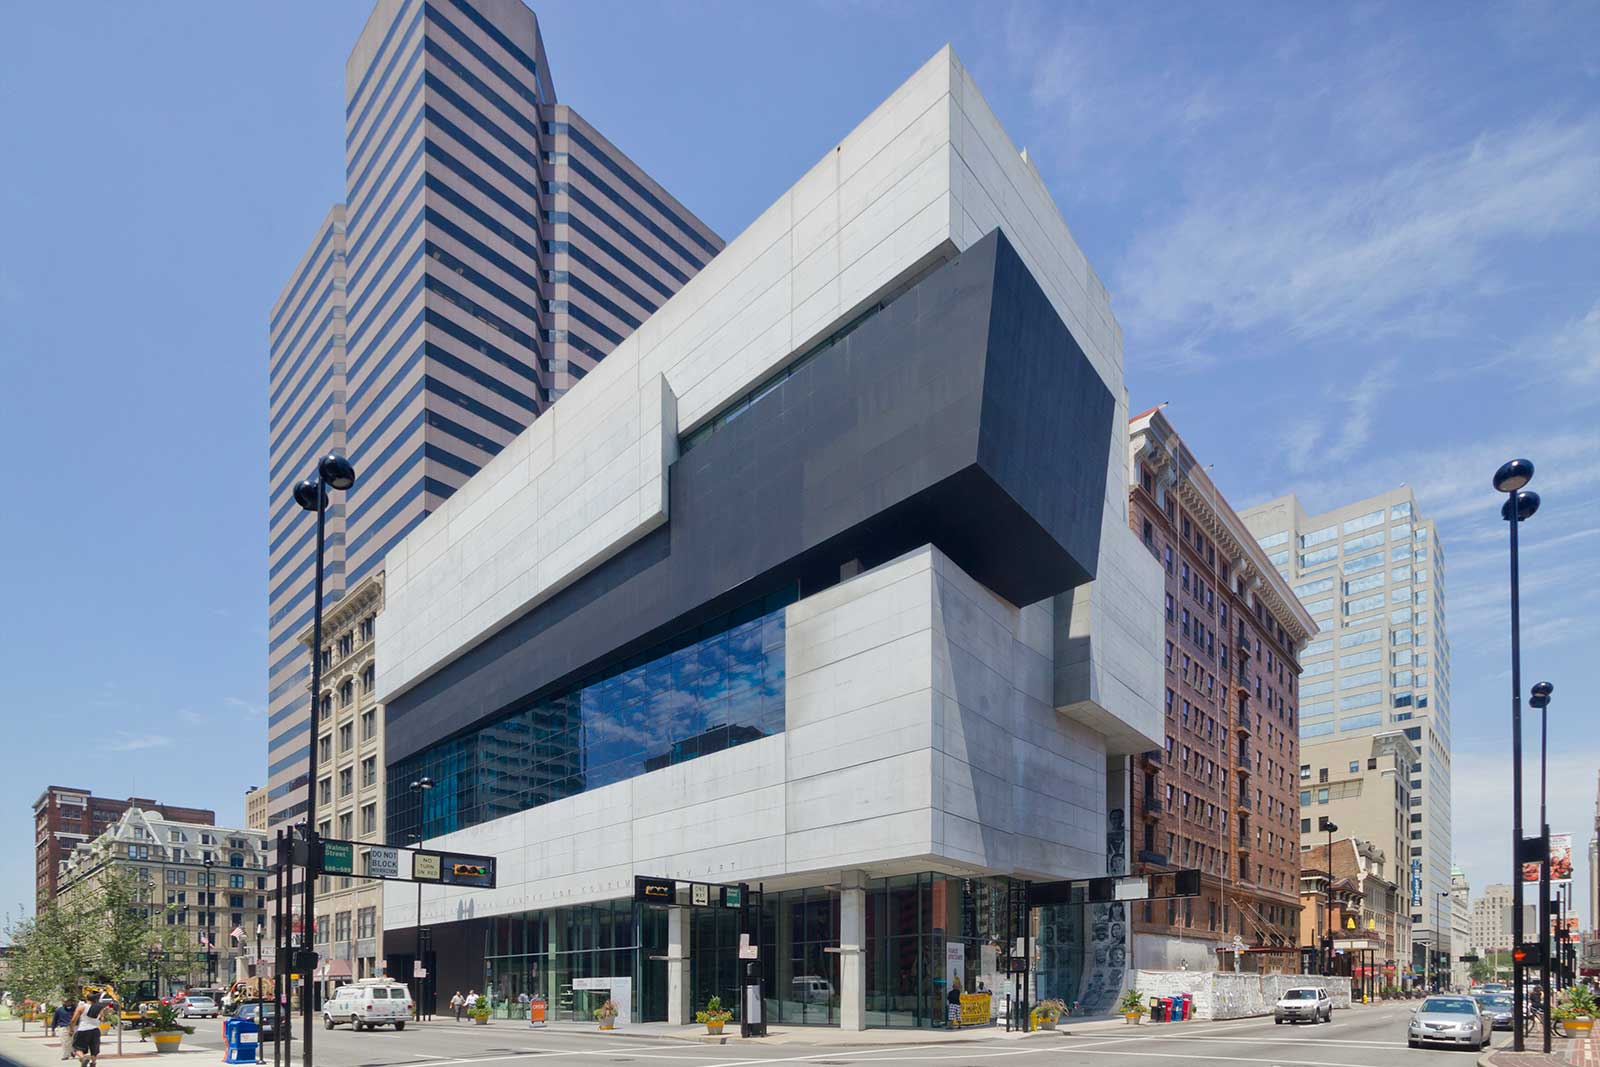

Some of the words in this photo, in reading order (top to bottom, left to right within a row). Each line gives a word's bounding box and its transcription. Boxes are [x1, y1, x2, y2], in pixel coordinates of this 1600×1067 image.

[325, 844, 349, 852] Walnut
[373, 850, 382, 858] DO
[384, 851, 397, 859] NOT
[372, 859, 398, 868] BLOCK
